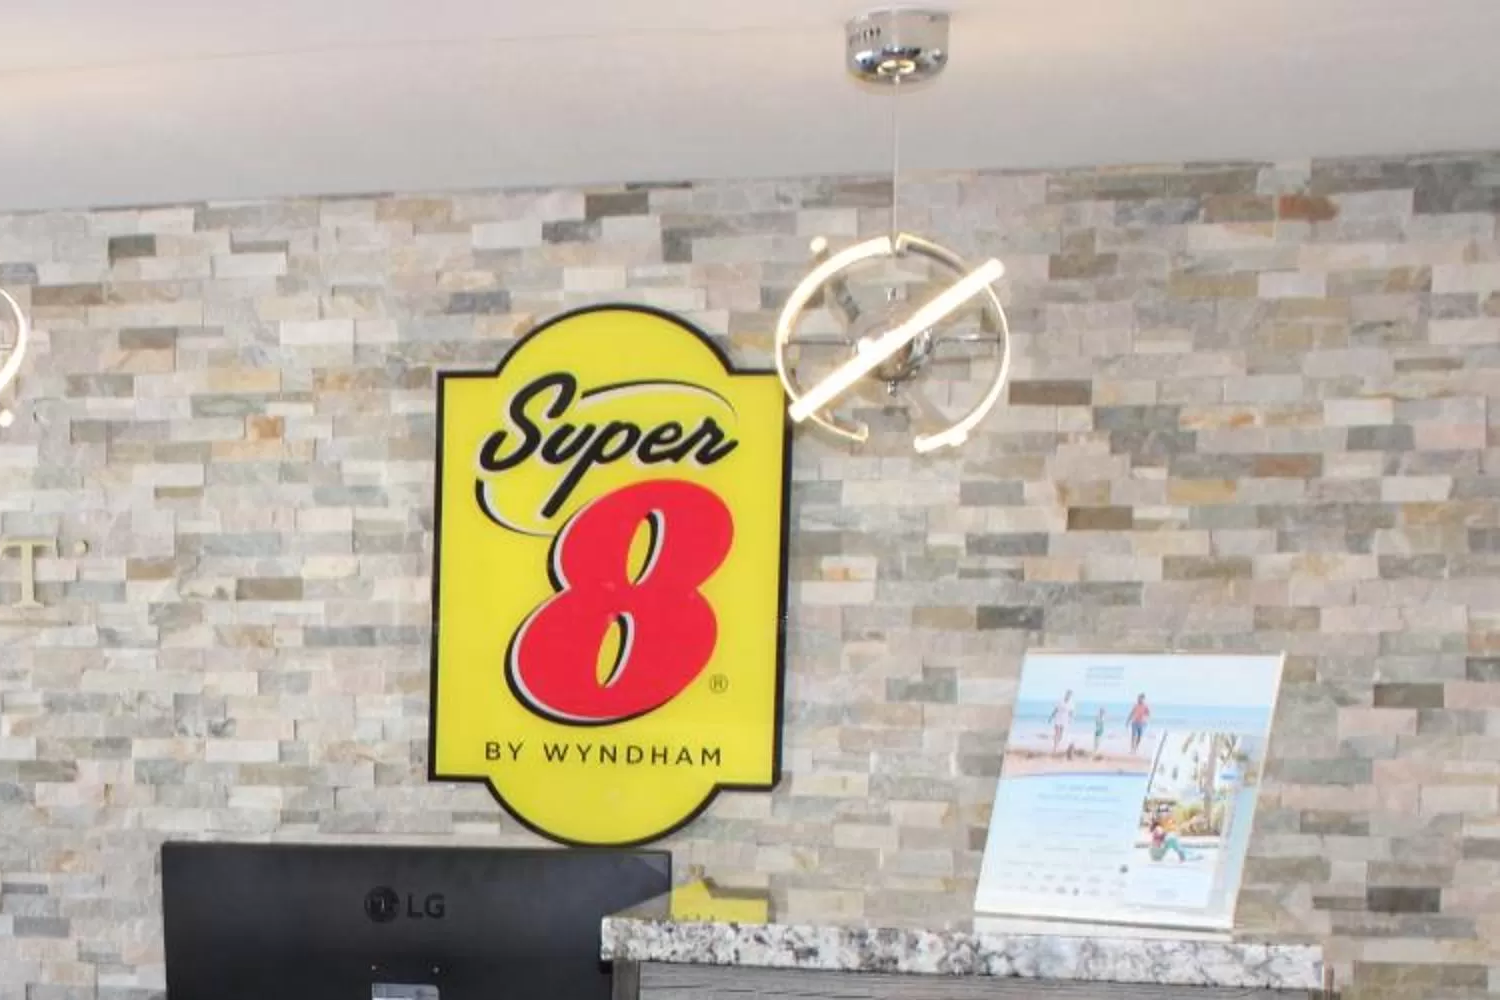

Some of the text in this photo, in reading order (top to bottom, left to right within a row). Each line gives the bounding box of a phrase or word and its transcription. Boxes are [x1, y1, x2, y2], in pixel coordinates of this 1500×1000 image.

[479, 371, 739, 519] Super
[504, 477, 736, 727] 8
[484, 741, 722, 767] BY WYNDHAM
[406, 892, 445, 918] LG
